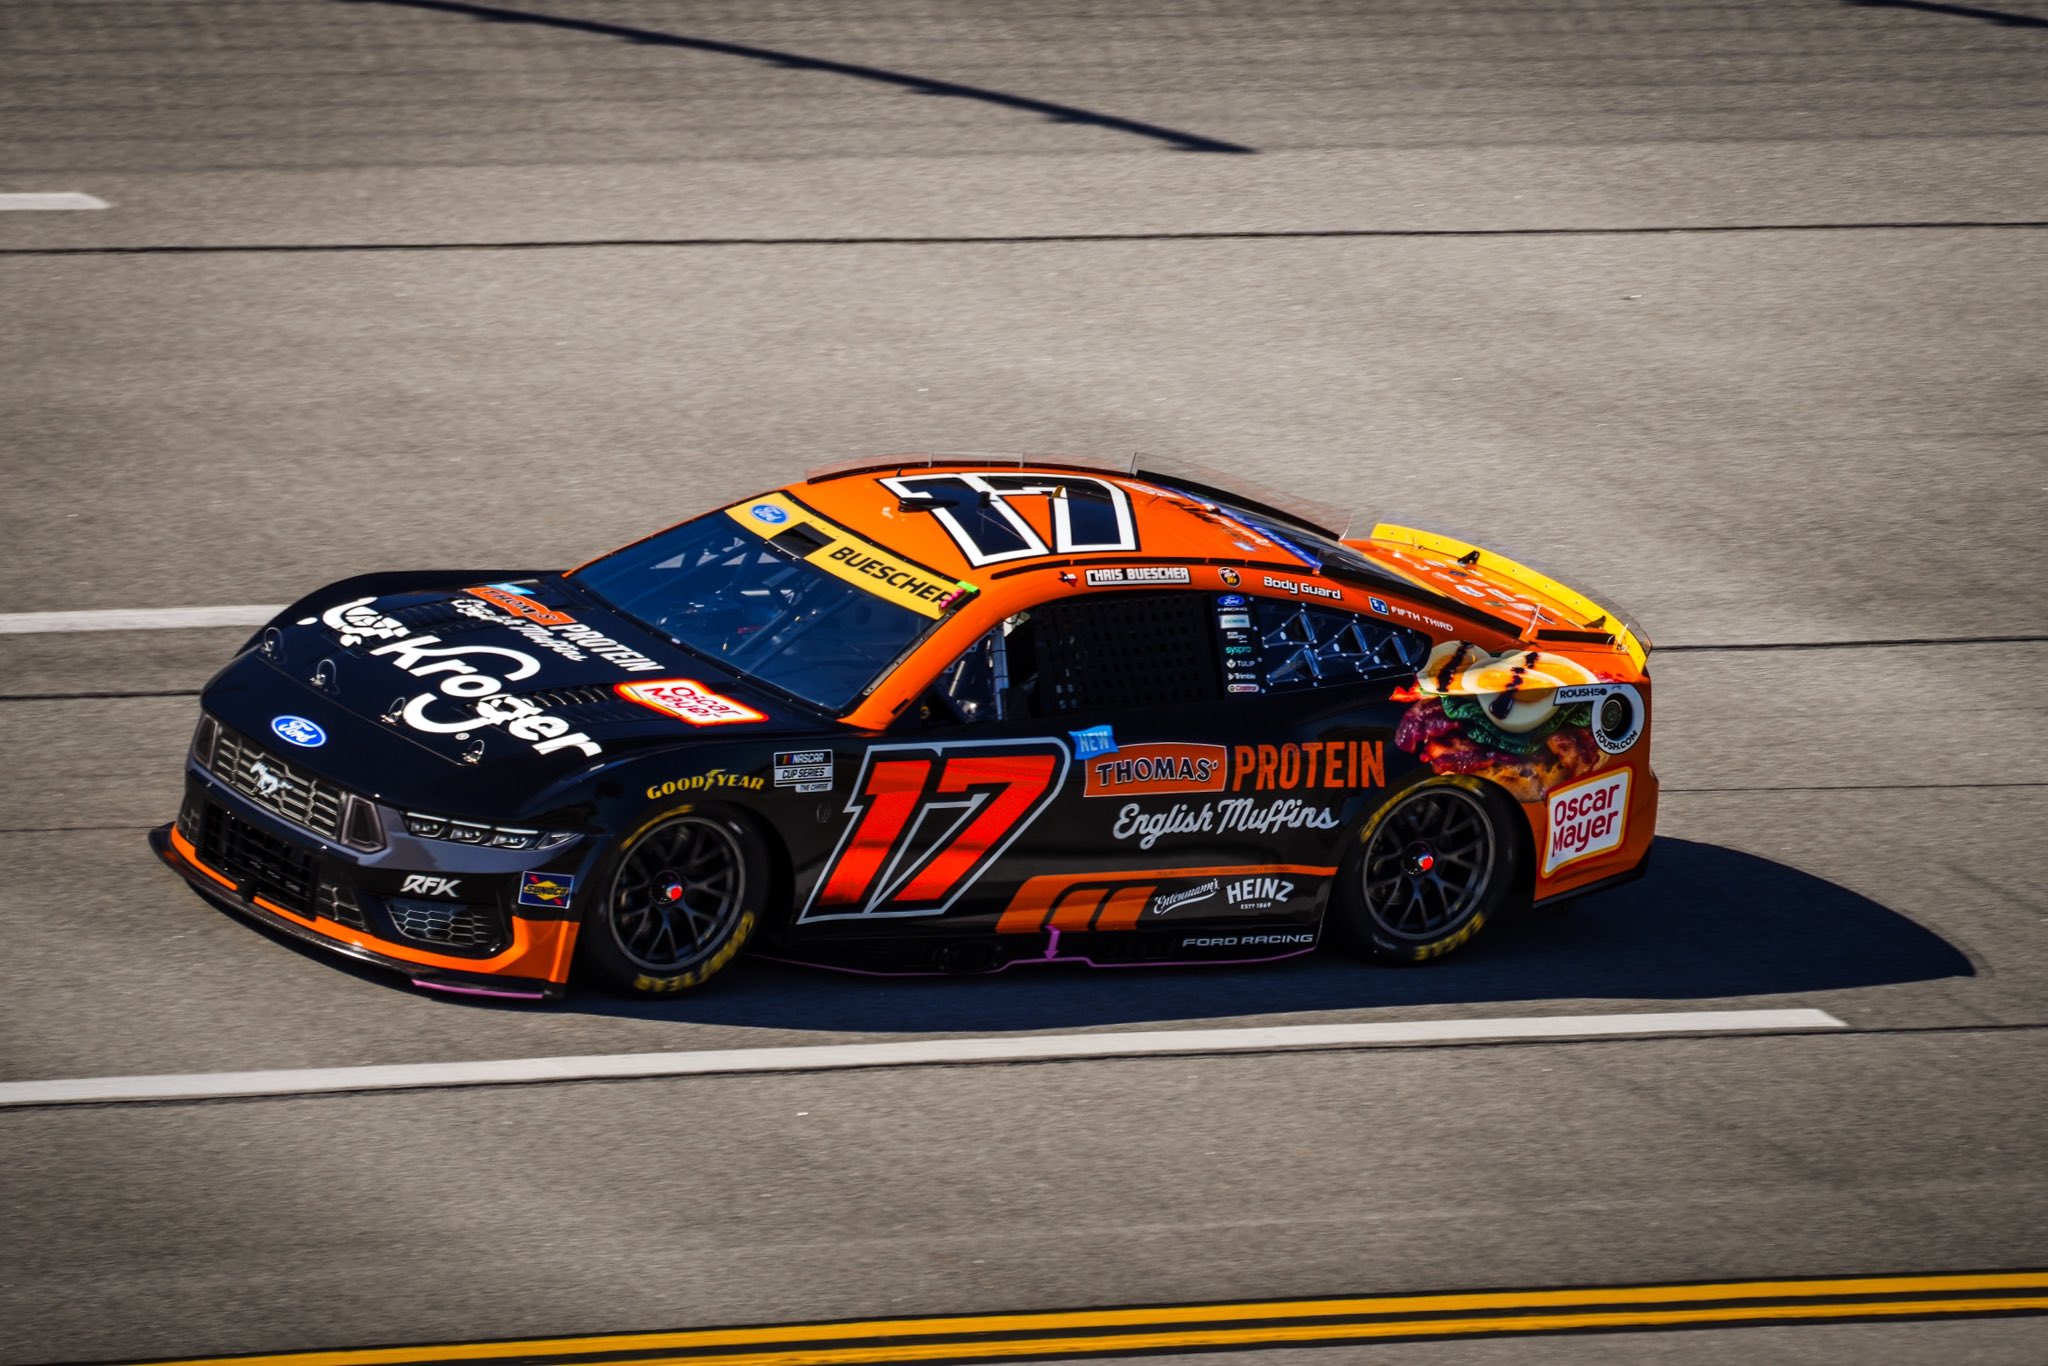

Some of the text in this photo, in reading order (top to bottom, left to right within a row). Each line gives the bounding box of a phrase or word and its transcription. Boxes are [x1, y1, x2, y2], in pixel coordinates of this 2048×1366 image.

[753, 505, 784, 522] Ford
[1086, 567, 1189, 583] CHRIS BUESCHER
[1263, 576, 1341, 600] Body Guard
[1391, 605, 1420, 622] FIFTH
[1424, 616, 1454, 632] THIRD
[548, 623, 665, 672] PROTEIN
[1225, 646, 1252, 655] syspro
[369, 634, 602, 757] Kroger
[671, 687, 743, 716] Oscar
[276, 719, 319, 744] Ford
[1078, 731, 1109, 753] NEW
[1594, 730, 1638, 751] ROUSH.COM
[793, 753, 824, 764] NASCAR
[1231, 740, 1385, 792] PROTEIN
[646, 768, 765, 799] GOODYEAR
[782, 768, 825, 779] CUP SERIES
[1554, 784, 1620, 827] Oscar
[804, 745, 1063, 915] 17
[1113, 802, 1212, 850] English
[1216, 797, 1339, 834] Muffins
[1552, 811, 1619, 857] Mayer
[400, 874, 463, 898] RFK
[524, 884, 570, 897] SUNOCO
[1226, 878, 1294, 904] HEINZ
[1182, 934, 1313, 948] FORD RACING
